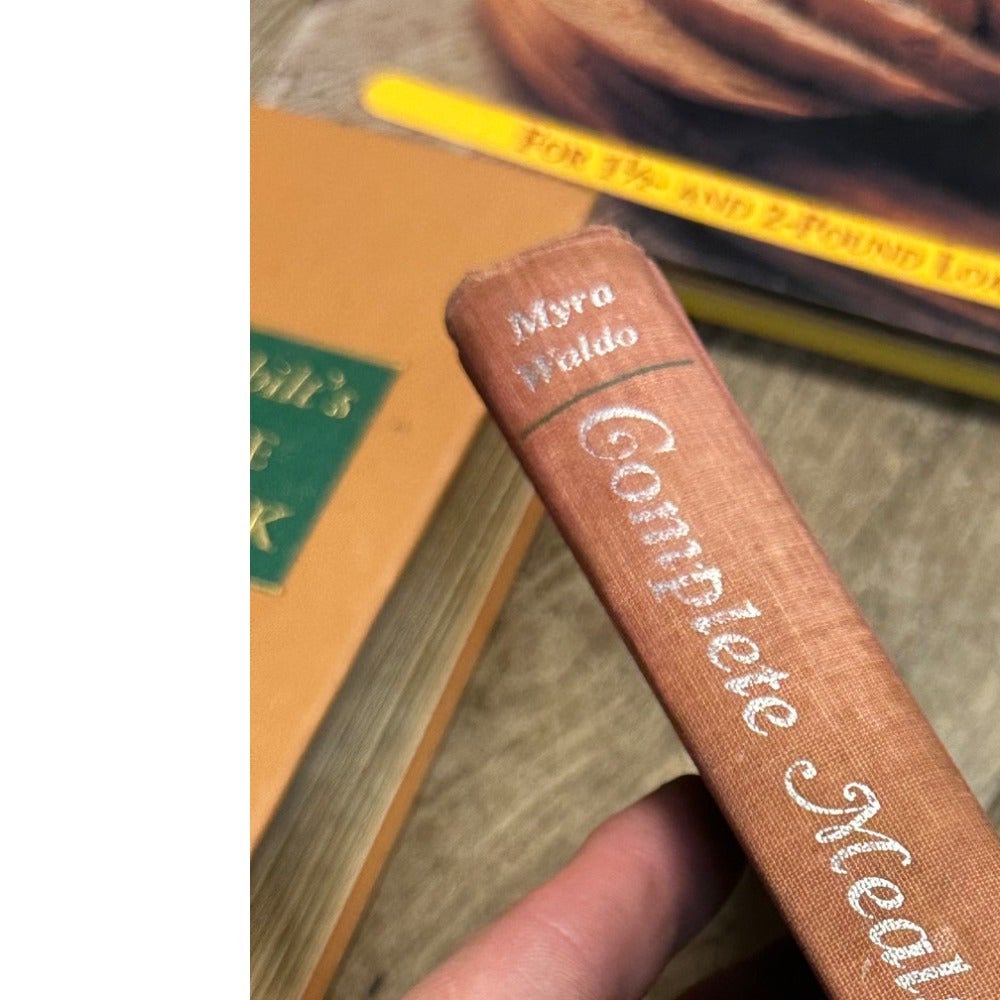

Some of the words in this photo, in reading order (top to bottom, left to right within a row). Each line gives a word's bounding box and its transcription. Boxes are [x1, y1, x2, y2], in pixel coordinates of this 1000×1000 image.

[507, 282, 616, 346] Myra
[512, 325, 639, 393] Waldo
[579, 405, 799, 737] Complete
